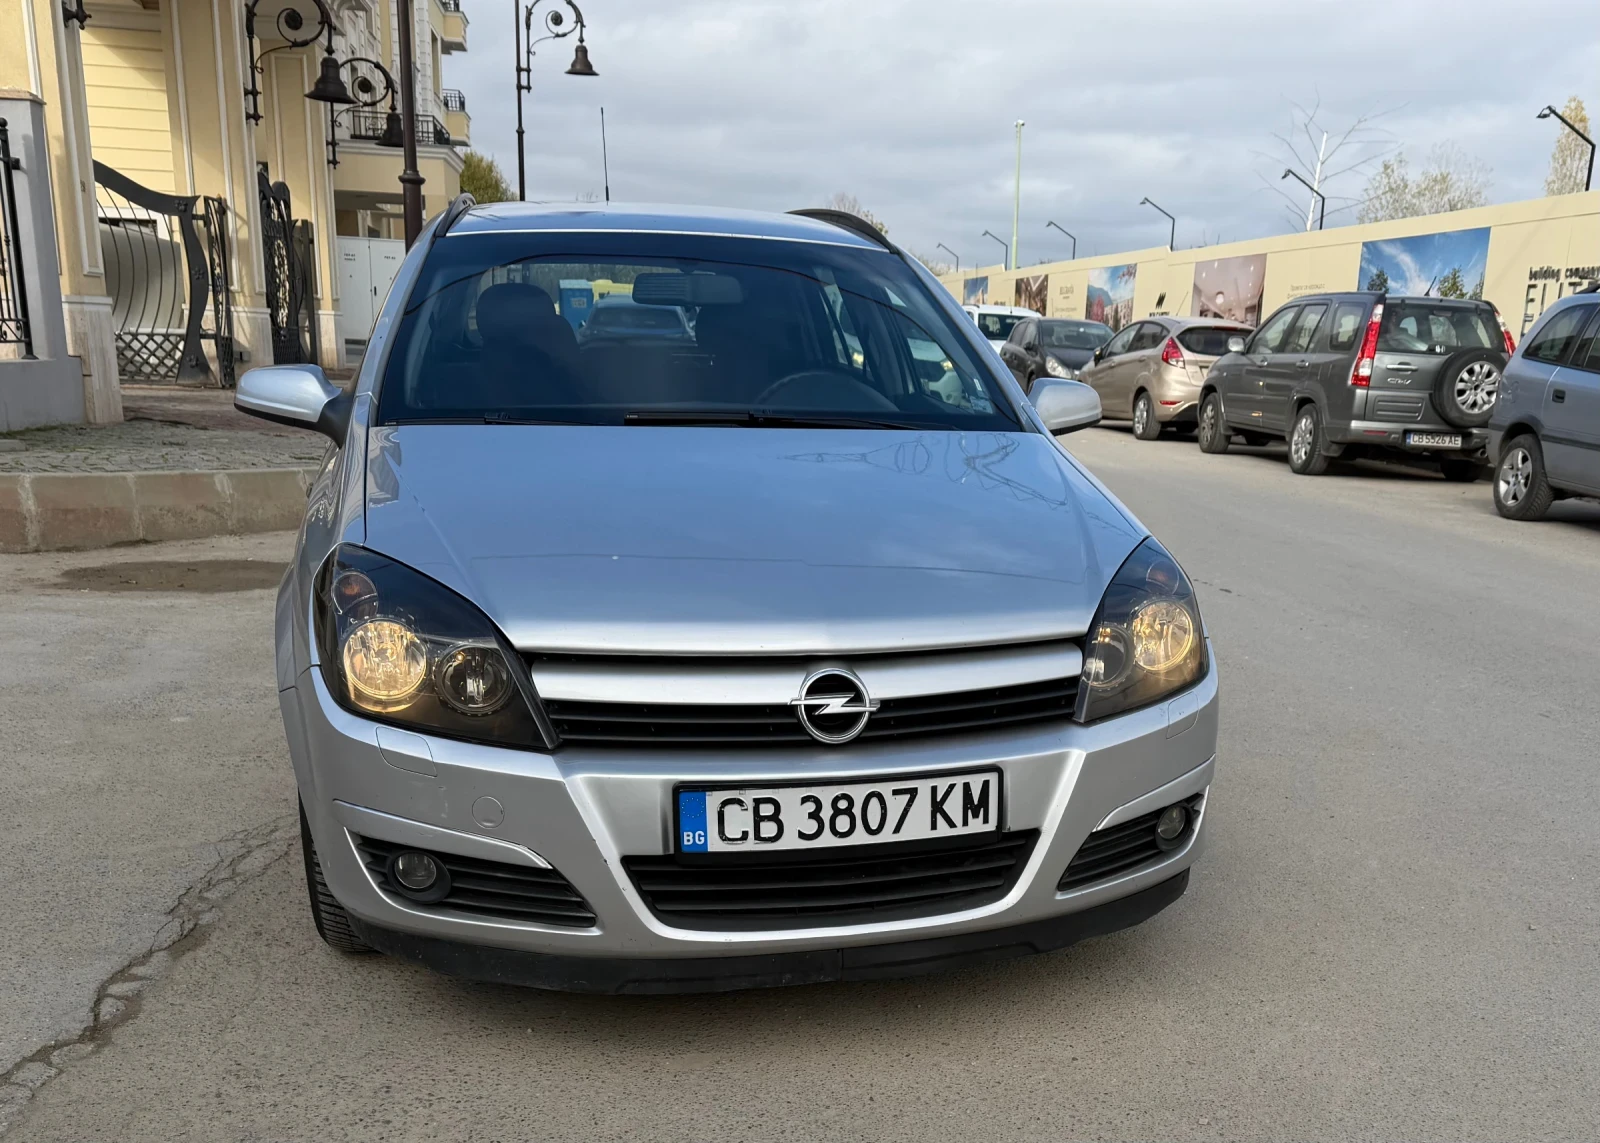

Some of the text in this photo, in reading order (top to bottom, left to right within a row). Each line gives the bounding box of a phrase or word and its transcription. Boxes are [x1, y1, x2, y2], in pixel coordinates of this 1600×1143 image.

[1529, 266, 1561, 283] building
[1412, 433, 1424, 444] CB
[1425, 434, 1447, 445] 5526
[1448, 435, 1460, 446] AE
[716, 779, 991, 845] CB 3807 KM
[683, 830, 705, 846] BG
